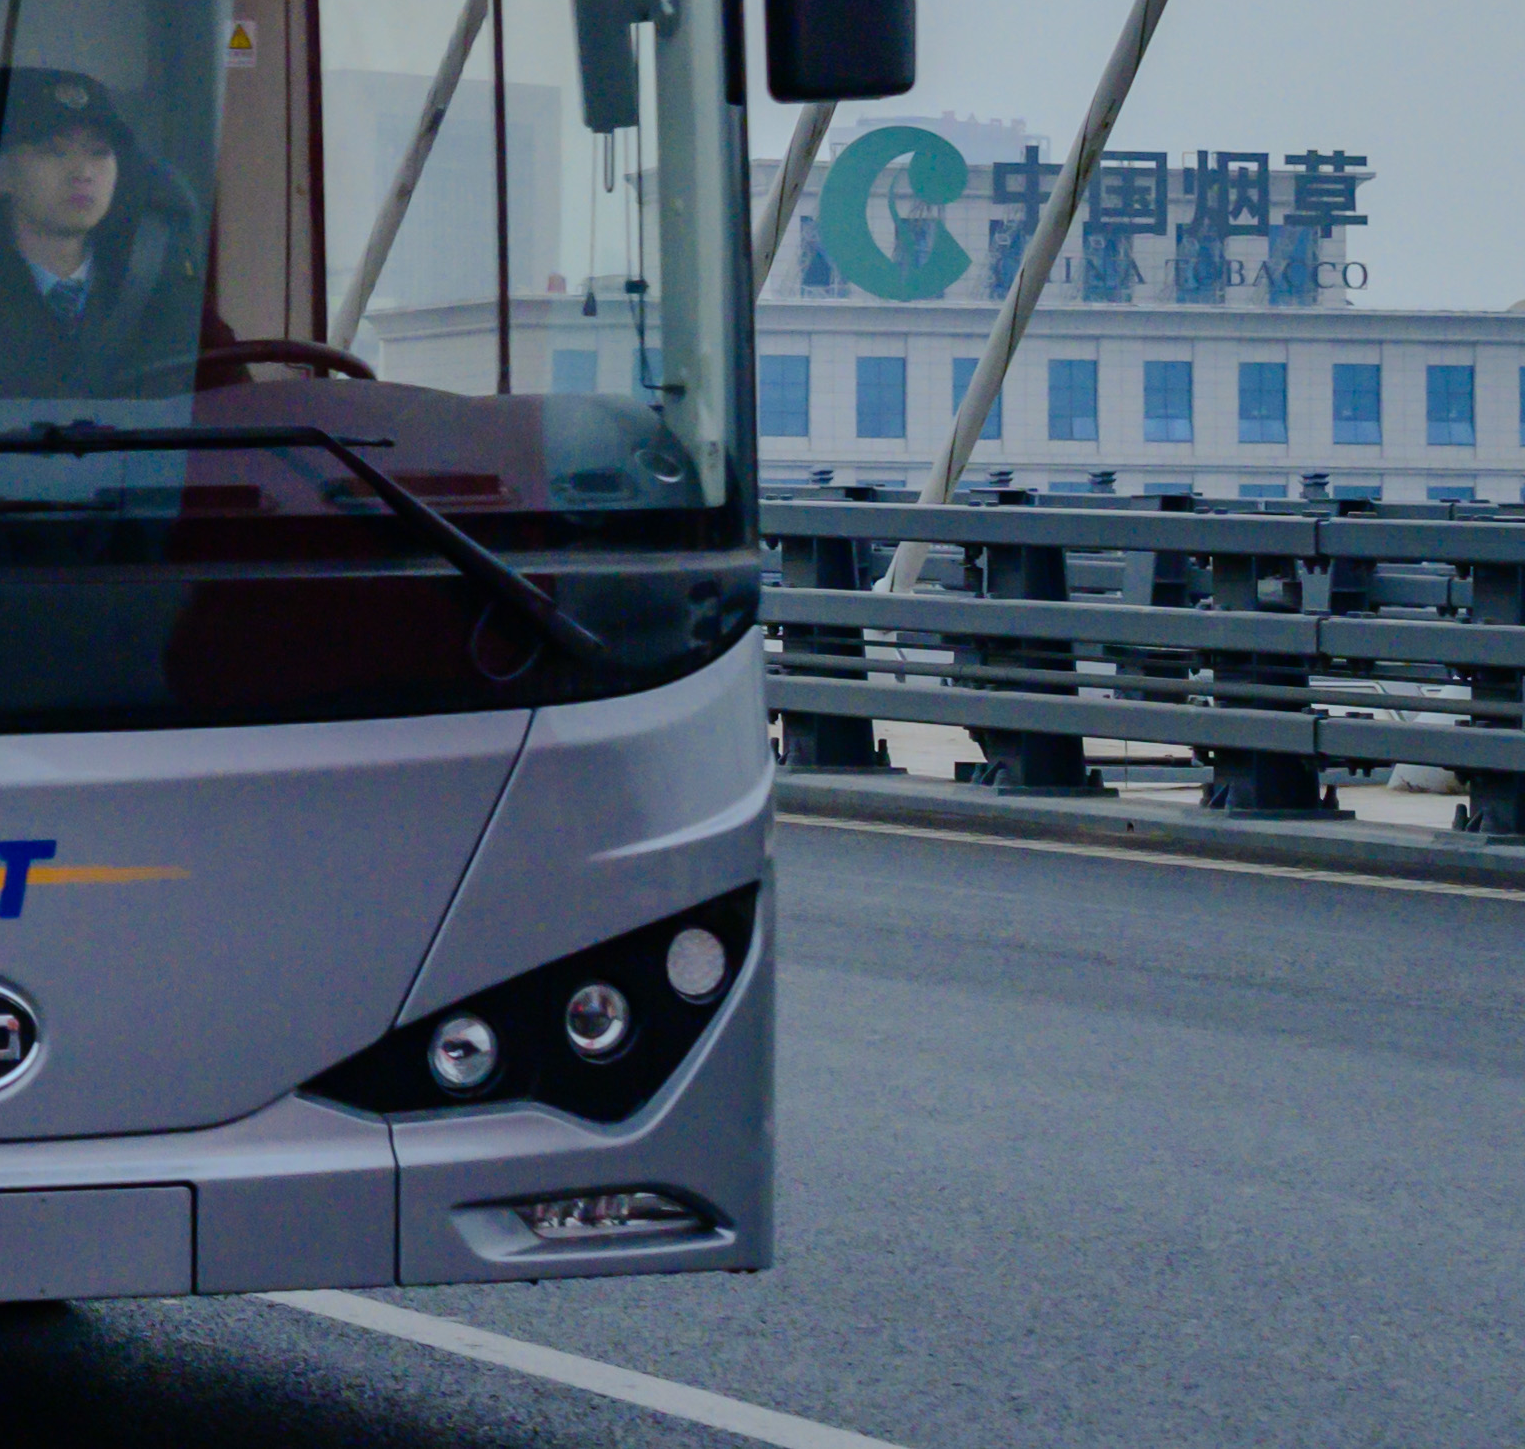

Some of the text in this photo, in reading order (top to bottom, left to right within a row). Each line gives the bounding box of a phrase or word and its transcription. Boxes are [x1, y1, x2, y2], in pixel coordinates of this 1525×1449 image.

[992, 144, 1369, 239] 中国烟草
[993, 256, 1369, 289] CINA TOBACCO
